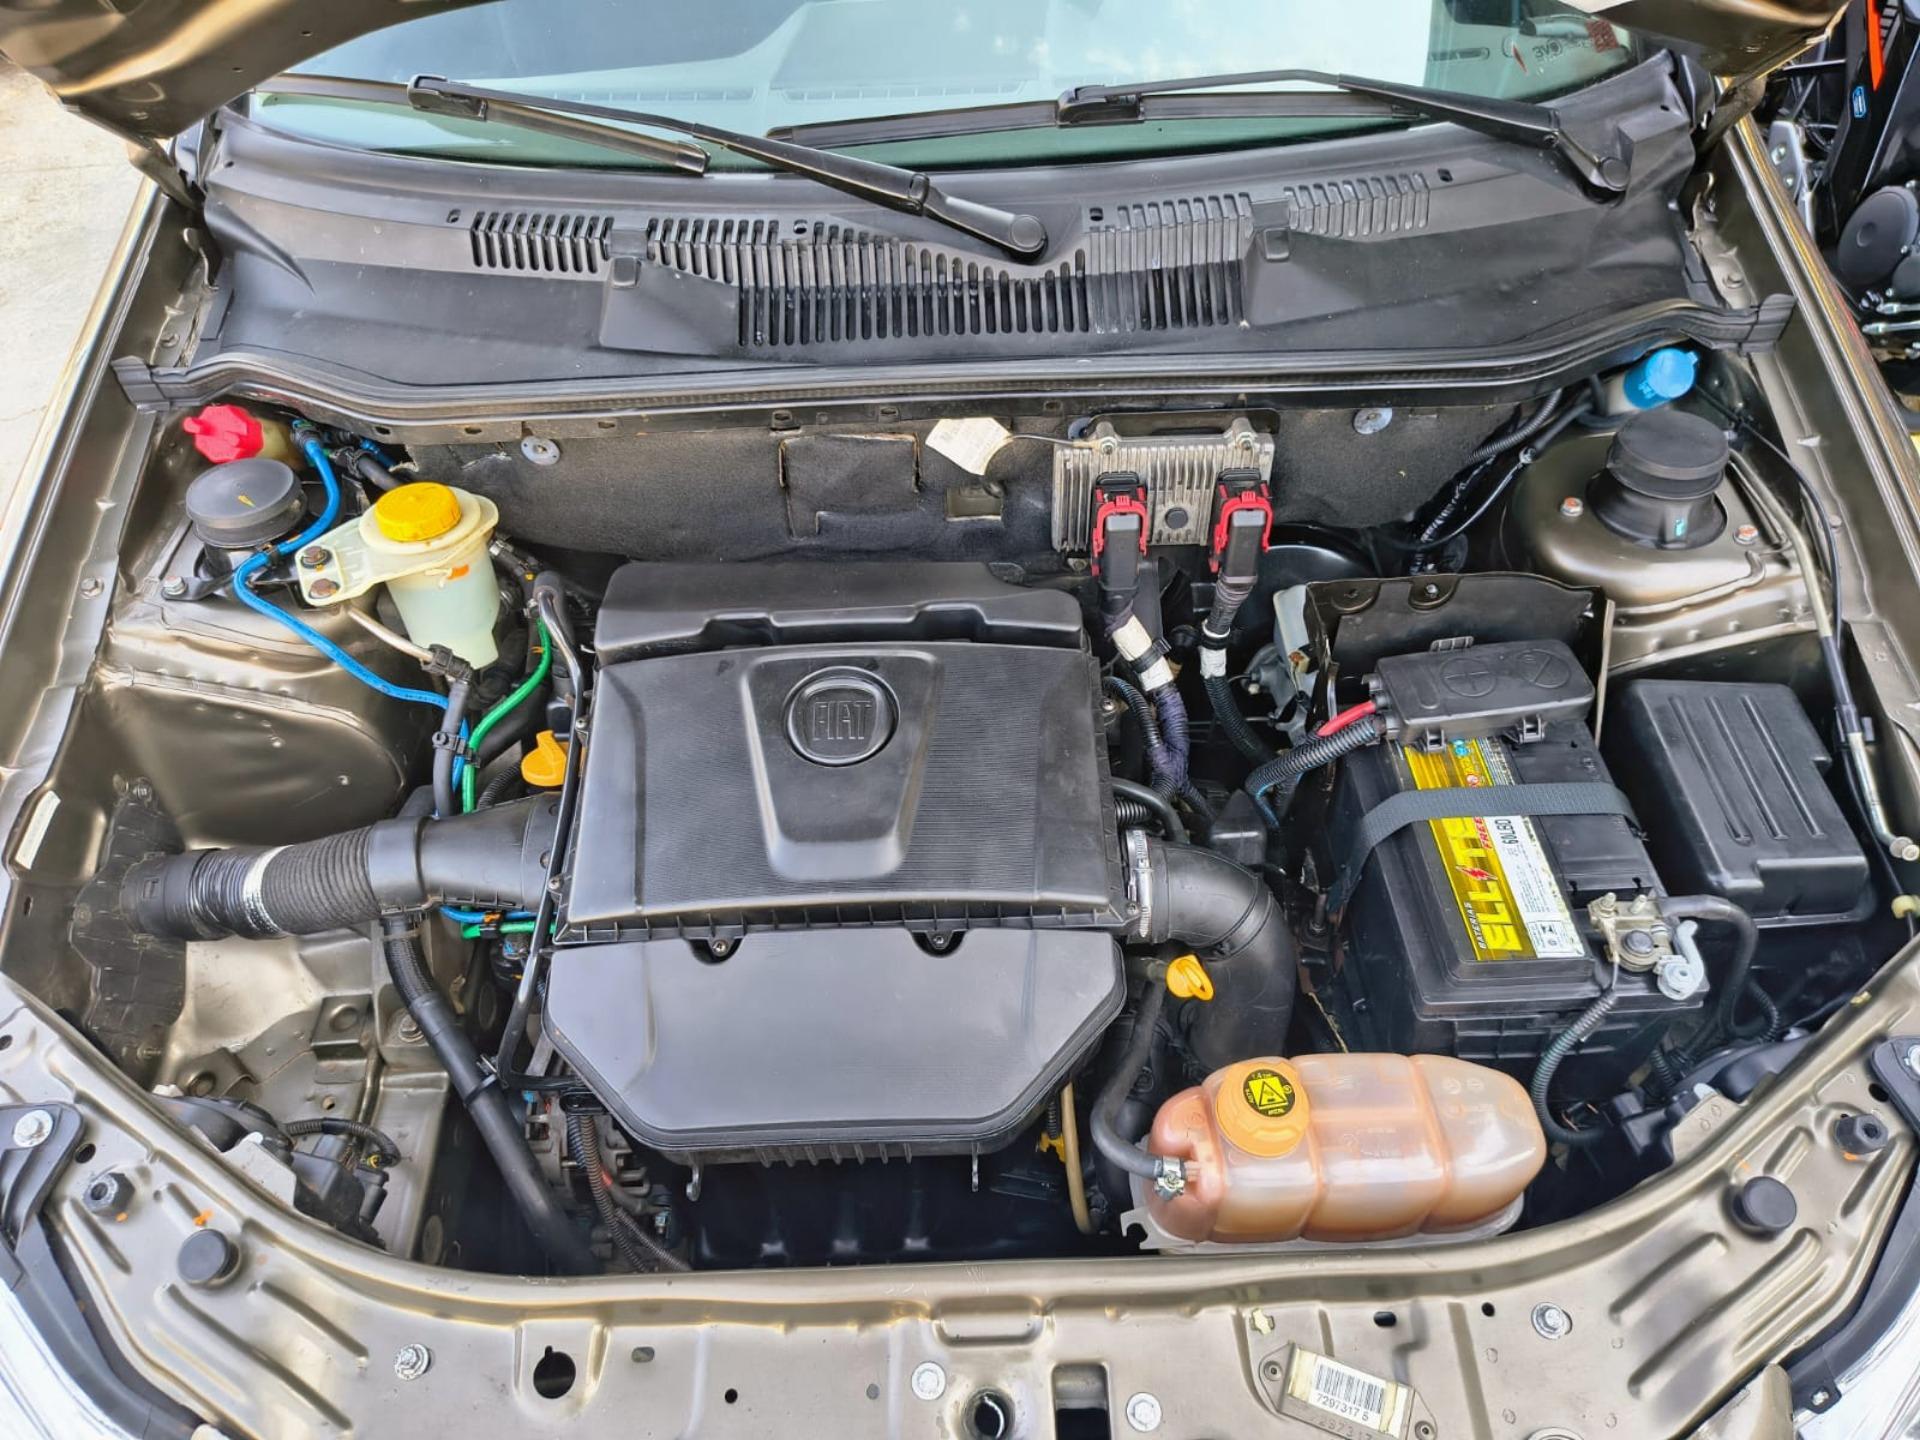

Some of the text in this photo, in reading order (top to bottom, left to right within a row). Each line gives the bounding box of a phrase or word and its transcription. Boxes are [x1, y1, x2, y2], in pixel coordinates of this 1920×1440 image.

[812, 700, 872, 741] FIAT
[1463, 901, 1487, 950] BATERIAS
[1316, 1393, 1360, 1418] 7297317
